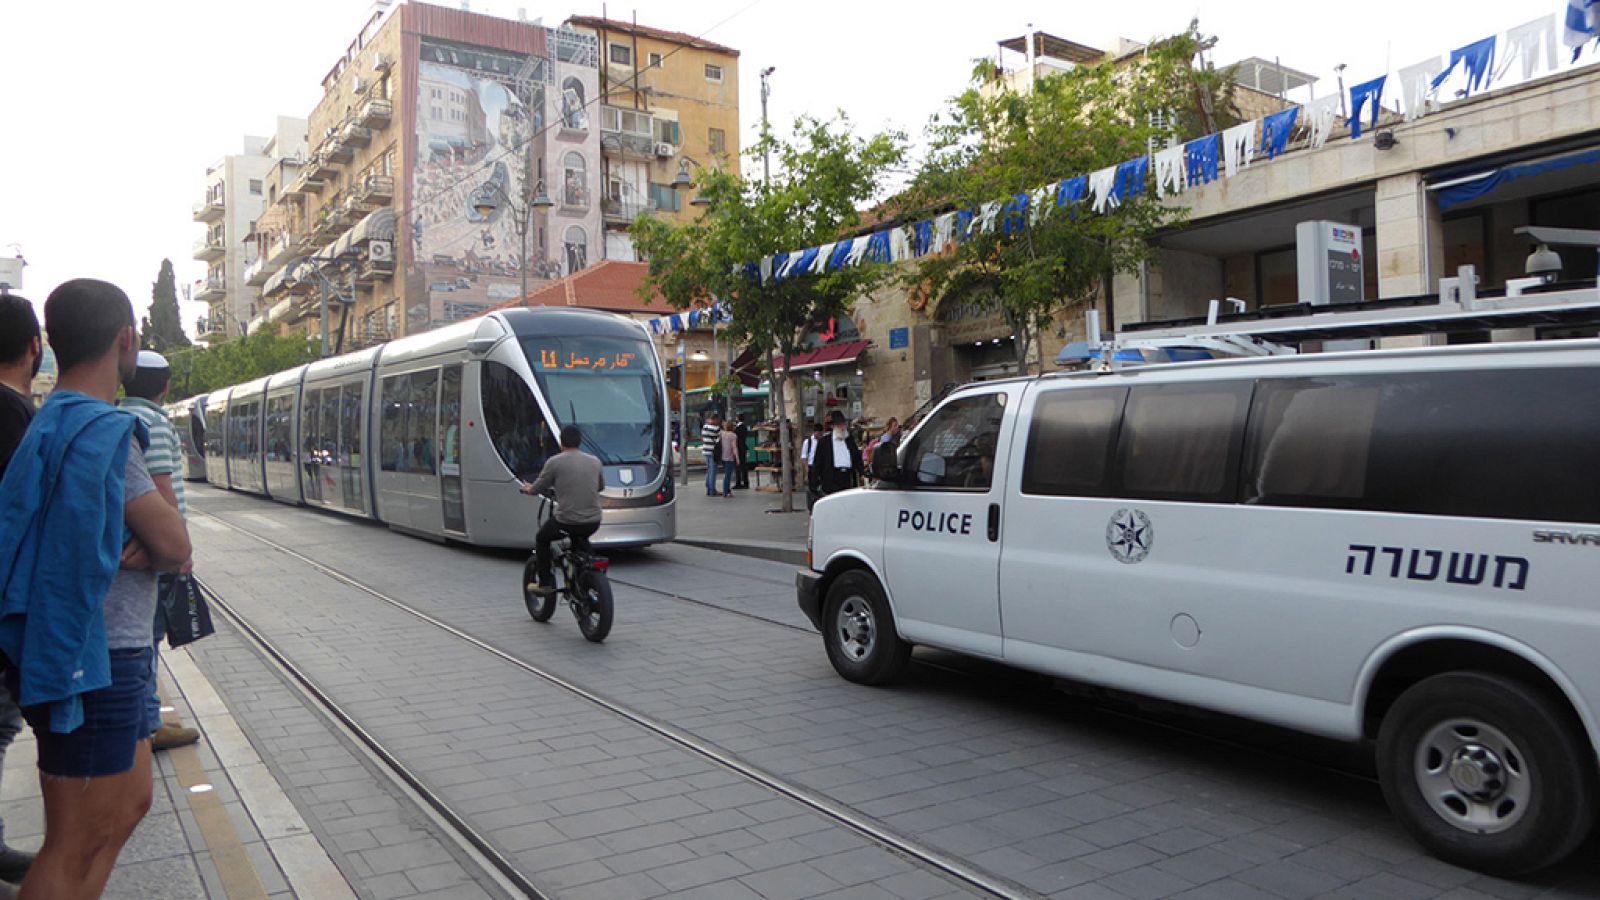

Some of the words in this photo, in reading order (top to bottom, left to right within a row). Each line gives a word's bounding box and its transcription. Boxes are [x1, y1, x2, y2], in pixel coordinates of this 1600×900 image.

[623, 488, 634, 496] 17
[898, 509, 973, 535] POLICE
[1345, 544, 1529, 590] משטרה
